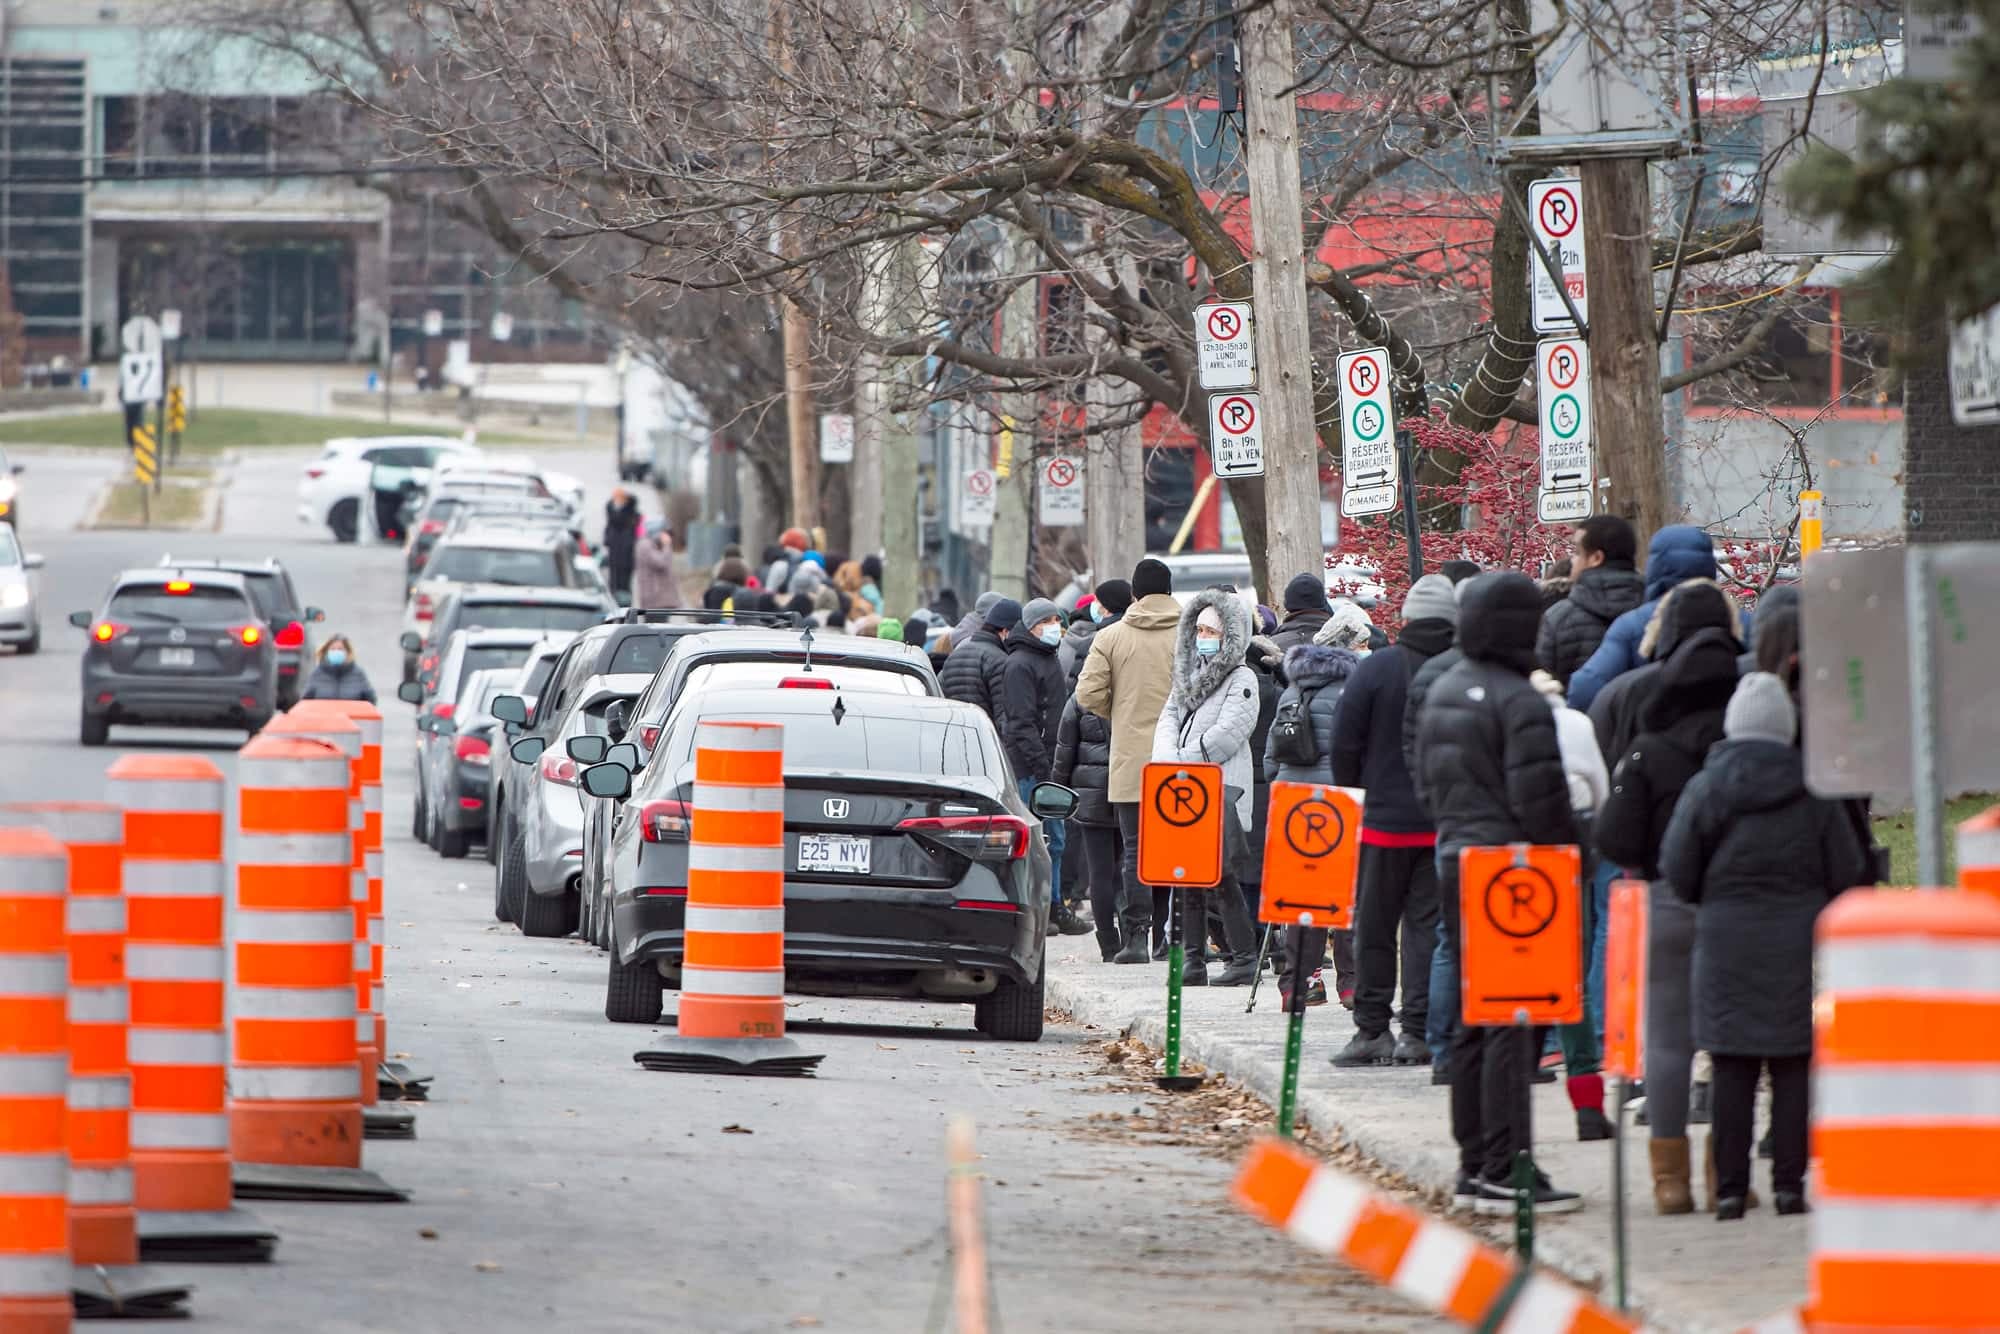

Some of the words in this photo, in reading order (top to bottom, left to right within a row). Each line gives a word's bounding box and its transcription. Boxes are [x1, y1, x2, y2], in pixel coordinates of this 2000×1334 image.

[1568, 283, 1582, 298] 62
[1203, 342, 1248, 352] 12h30-15h30
[1216, 351, 1237, 360] LUNDI
[1222, 438, 1233, 448] 8h
[1241, 436, 1256, 447] 19h
[1219, 451, 1233, 461] LUN
[1245, 448, 1260, 459] VEN
[1349, 493, 1390, 507] DIMANCHE
[1546, 499, 1587, 511] DIMANCHE
[801, 842, 830, 860] E25
[840, 843, 868, 862] NYV
